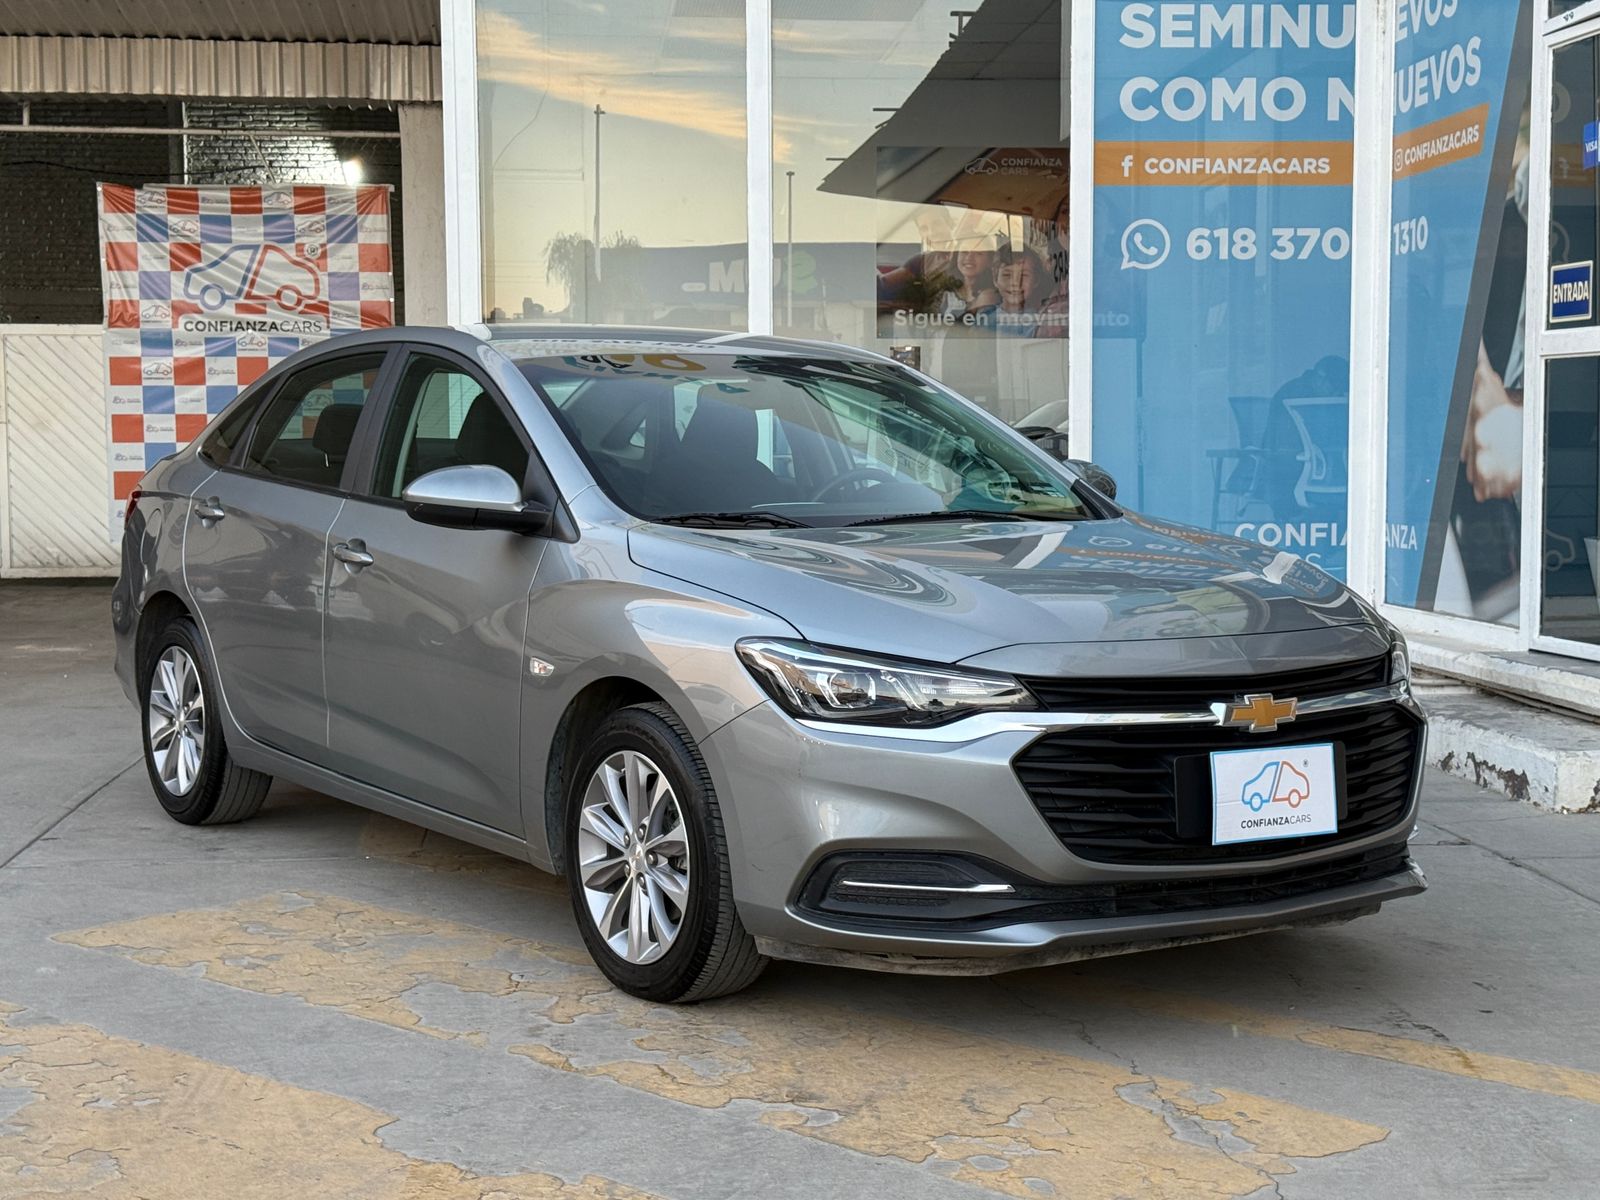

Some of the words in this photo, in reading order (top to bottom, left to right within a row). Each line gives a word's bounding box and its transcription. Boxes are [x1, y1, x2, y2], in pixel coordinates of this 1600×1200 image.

[1119, 3, 1355, 49] SEMINU
[1394, 36, 1482, 116] UEVOS
[1119, 76, 1307, 122] COMO
[1404, 124, 1480, 166] CONFIANZACARS
[1001, 158, 1062, 167] CONFIANZA
[1144, 157, 1331, 174] CONFIANZACARS
[1186, 227, 1257, 260] 618
[1270, 227, 1350, 260] 370
[1393, 216, 1428, 255] 1310
[1553, 280, 1589, 304] ENTRADA
[184, 320, 322, 333] CONFIANZACARS
[894, 310, 956, 329] Sigue
[963, 313, 989, 327] en
[1241, 814, 1312, 829] CONFIANZACARS
